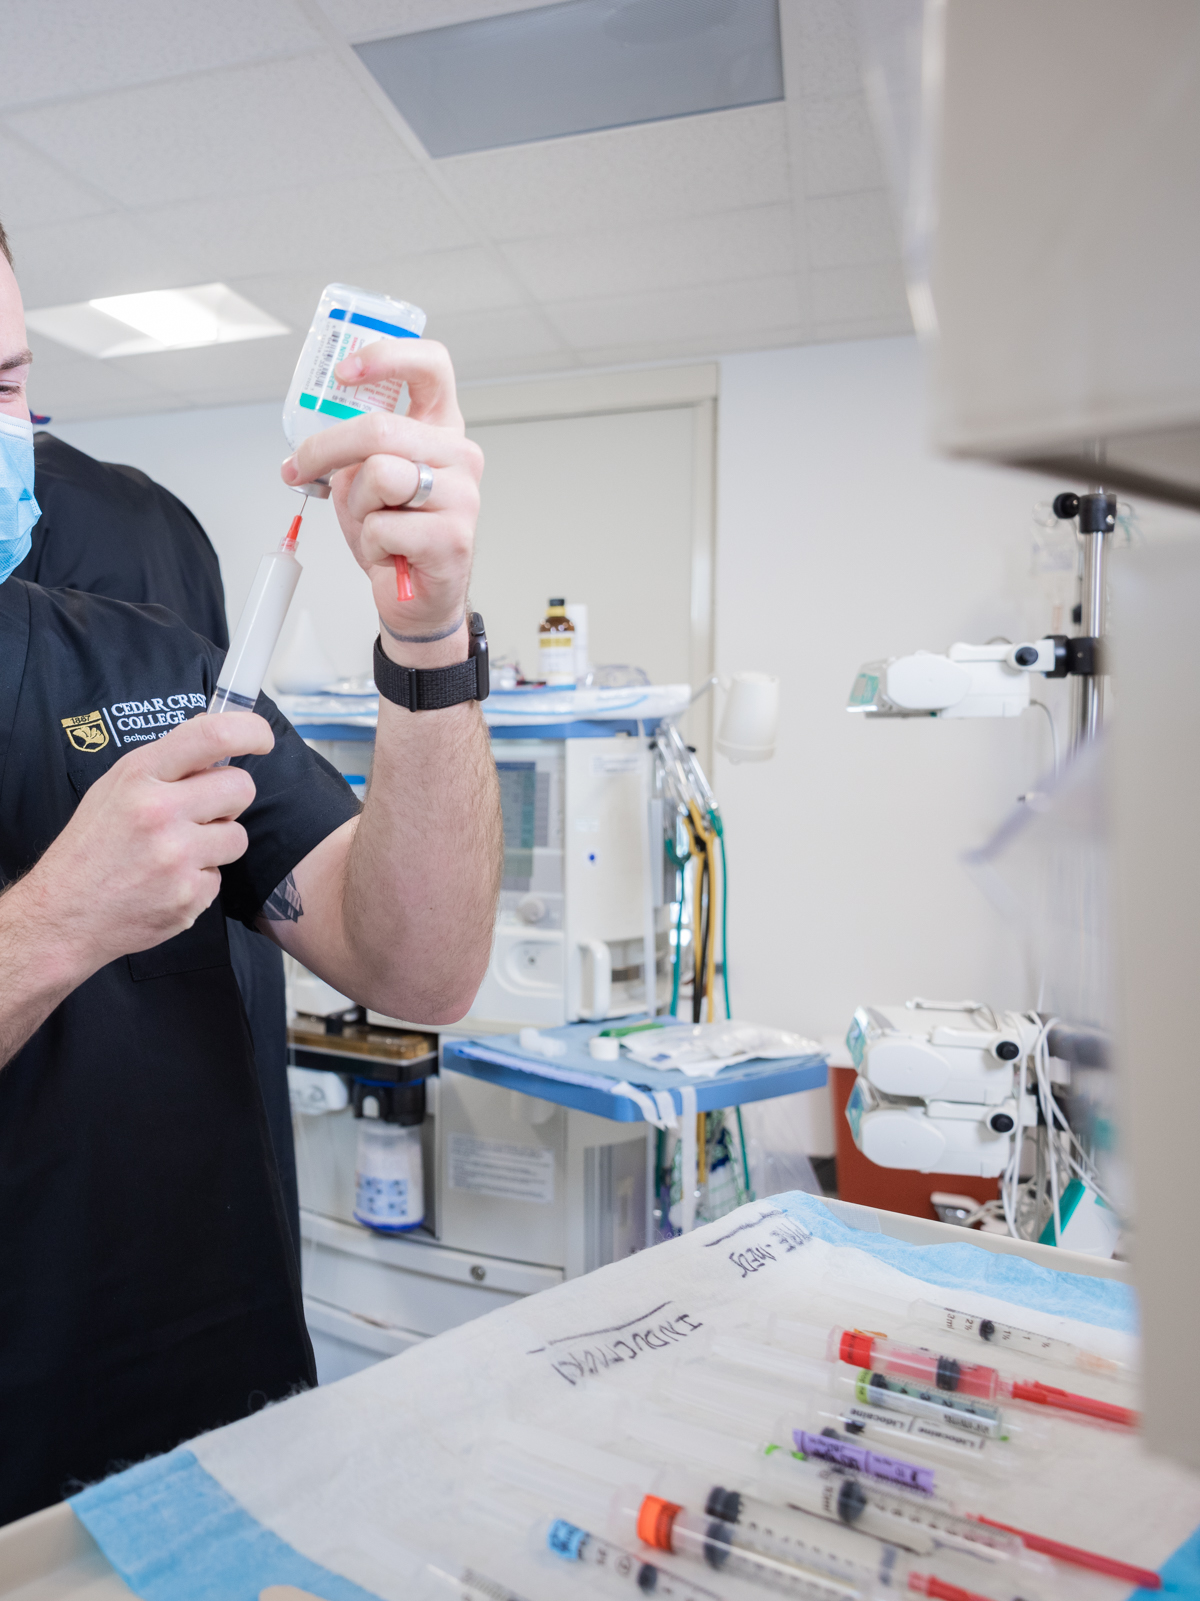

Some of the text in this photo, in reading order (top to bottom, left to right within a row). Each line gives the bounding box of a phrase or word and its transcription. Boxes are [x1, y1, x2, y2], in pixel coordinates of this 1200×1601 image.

[342, 333, 351, 345] DO
[336, 346, 347, 362] NOT
[111, 699, 170, 717] CEDAR
[70, 714, 91, 725] 1867
[116, 710, 188, 731] COLLEGE
[123, 731, 157, 743] School
[850, 1408, 905, 1429] Lidocaine
[918, 1426, 975, 1448] Lidocaine
